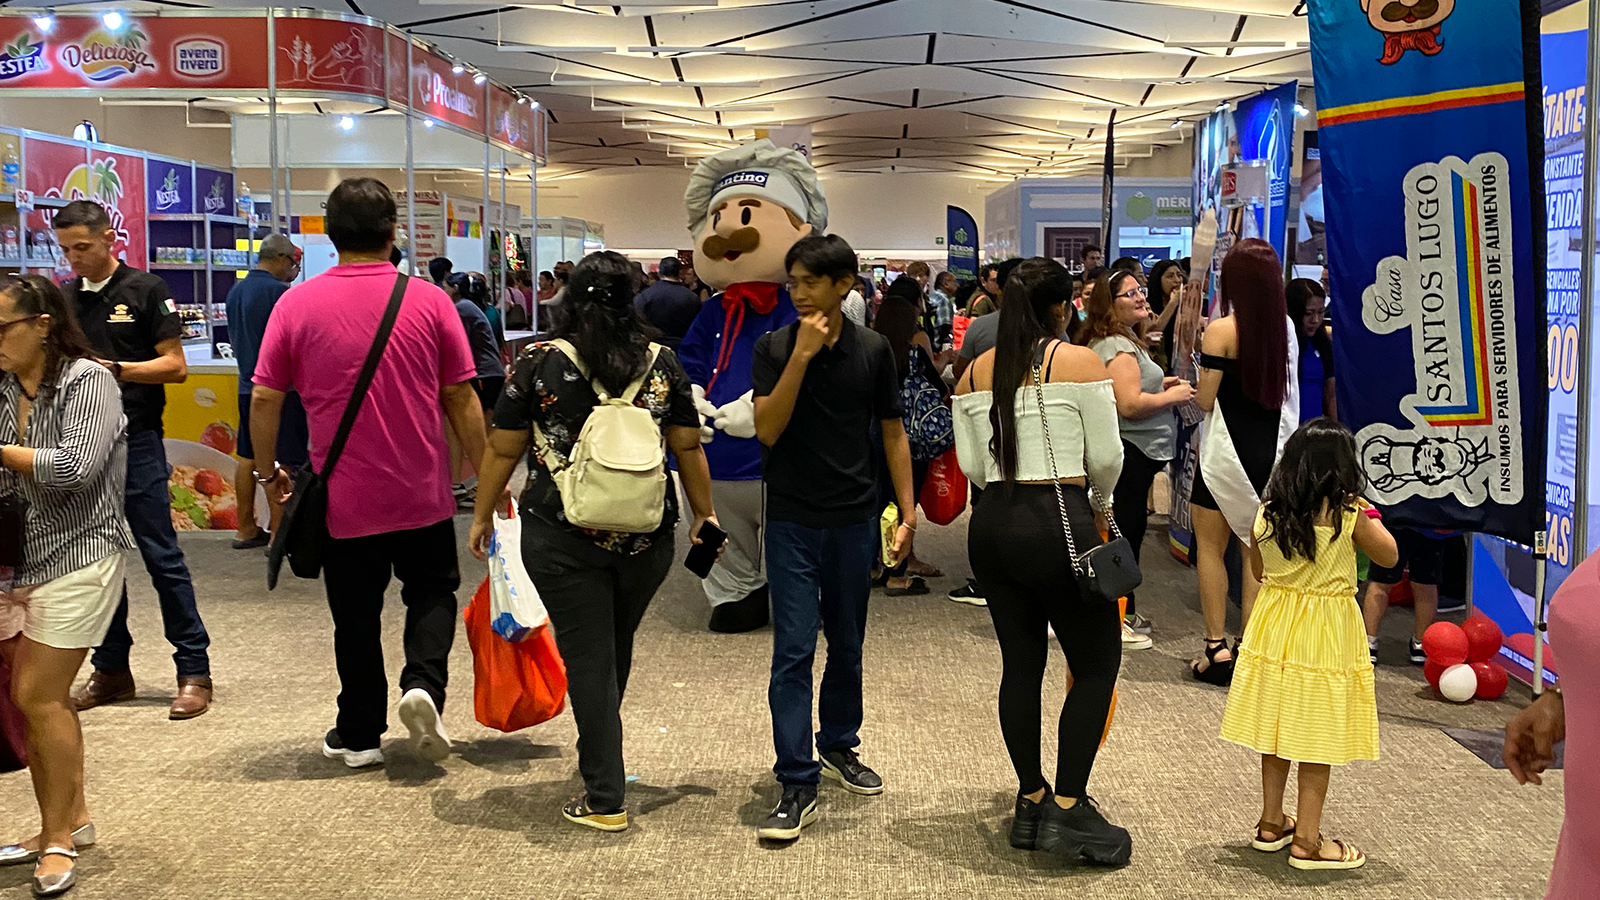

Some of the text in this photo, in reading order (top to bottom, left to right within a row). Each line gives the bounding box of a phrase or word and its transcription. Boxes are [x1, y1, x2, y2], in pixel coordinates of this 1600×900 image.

[0, 55, 46, 75] ESTEA
[62, 40, 154, 68] Deliciosa
[180, 48, 217, 59] avena
[180, 59, 218, 71] rivero
[1545, 153, 1584, 180] ONSTANTE
[1156, 194, 1192, 208] MÉRI
[1546, 189, 1582, 229] ENDA
[1374, 268, 1404, 323] Casa
[1416, 174, 1453, 404] SANTOS LUGO
[1560, 291, 1579, 315] POR
[1481, 165, 1511, 493] INSUMOS PARA SERVIDORES DE ALIMENTOS
[1546, 511, 1571, 566] AS
